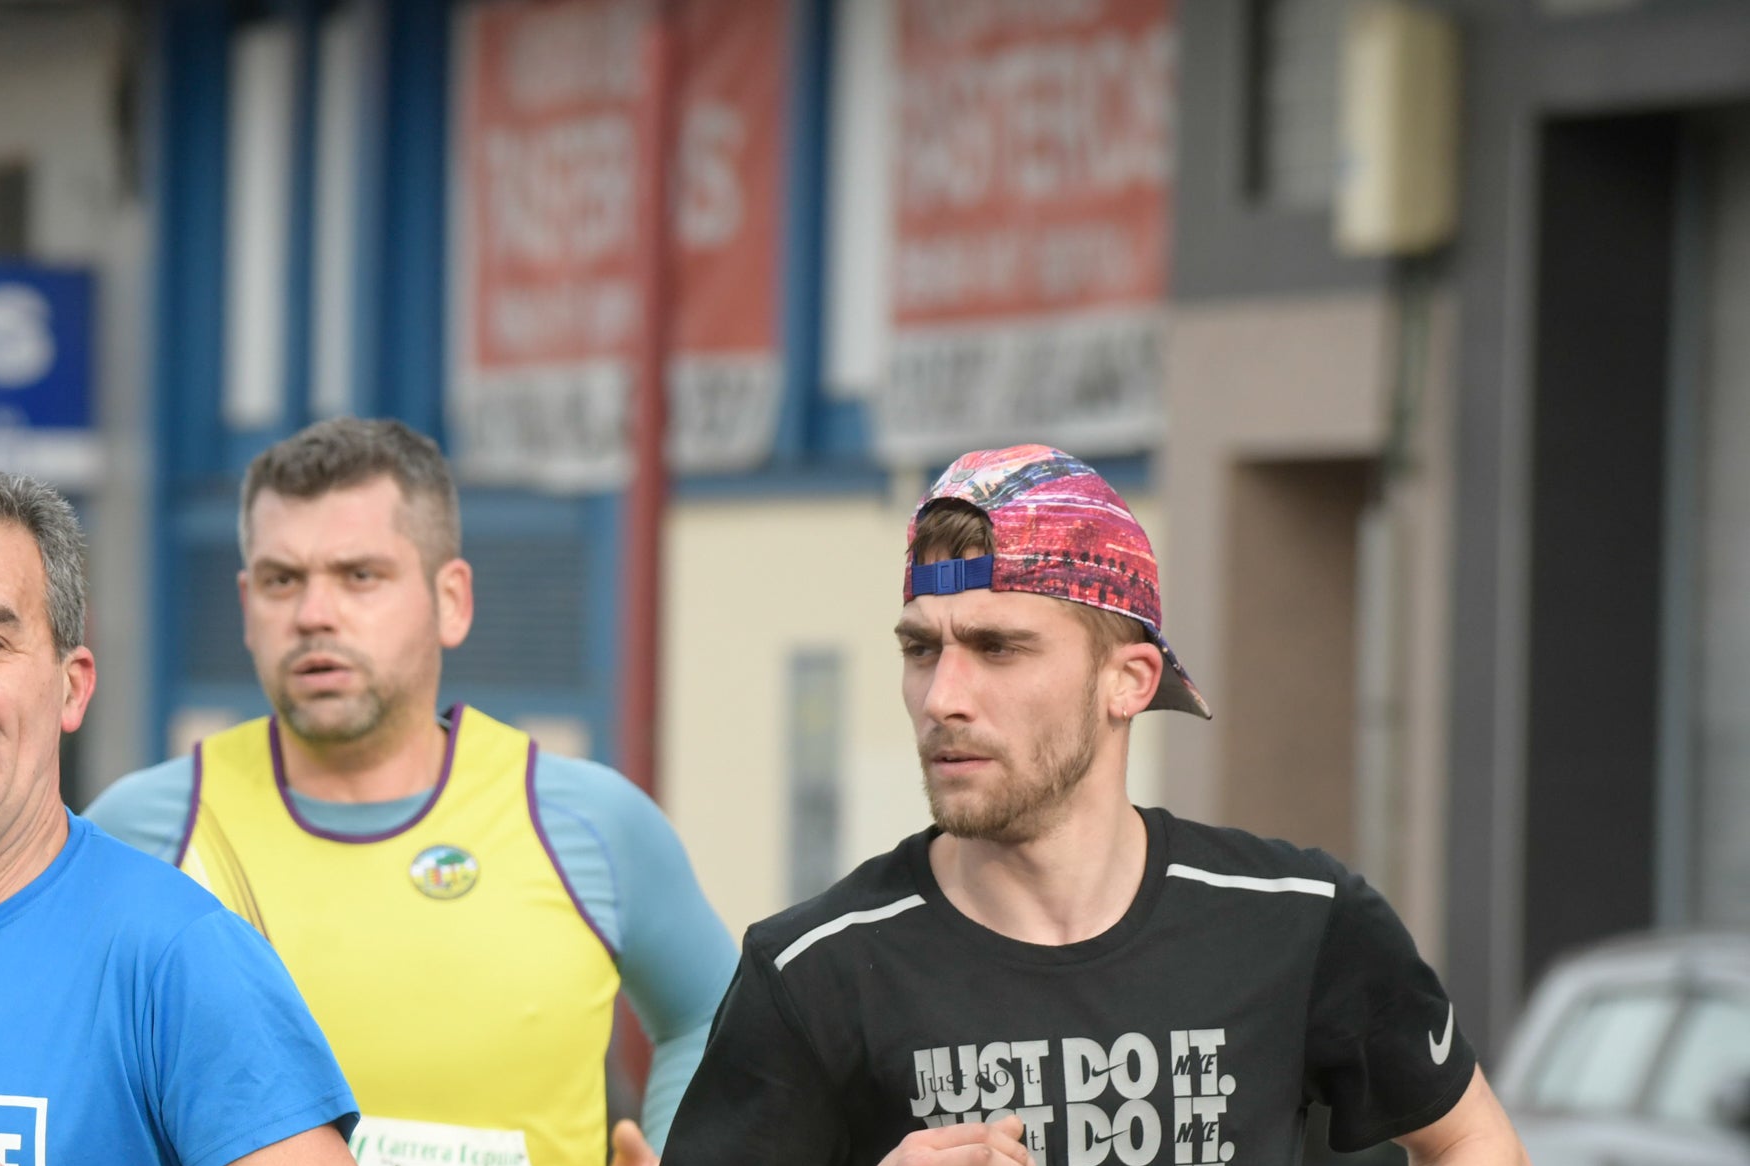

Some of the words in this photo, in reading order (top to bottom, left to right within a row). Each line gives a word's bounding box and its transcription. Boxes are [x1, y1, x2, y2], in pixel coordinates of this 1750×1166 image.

[910, 1041, 1049, 1117] JUST
[1062, 1032, 1159, 1102] DO
[1170, 1028, 1236, 1096] IT.
